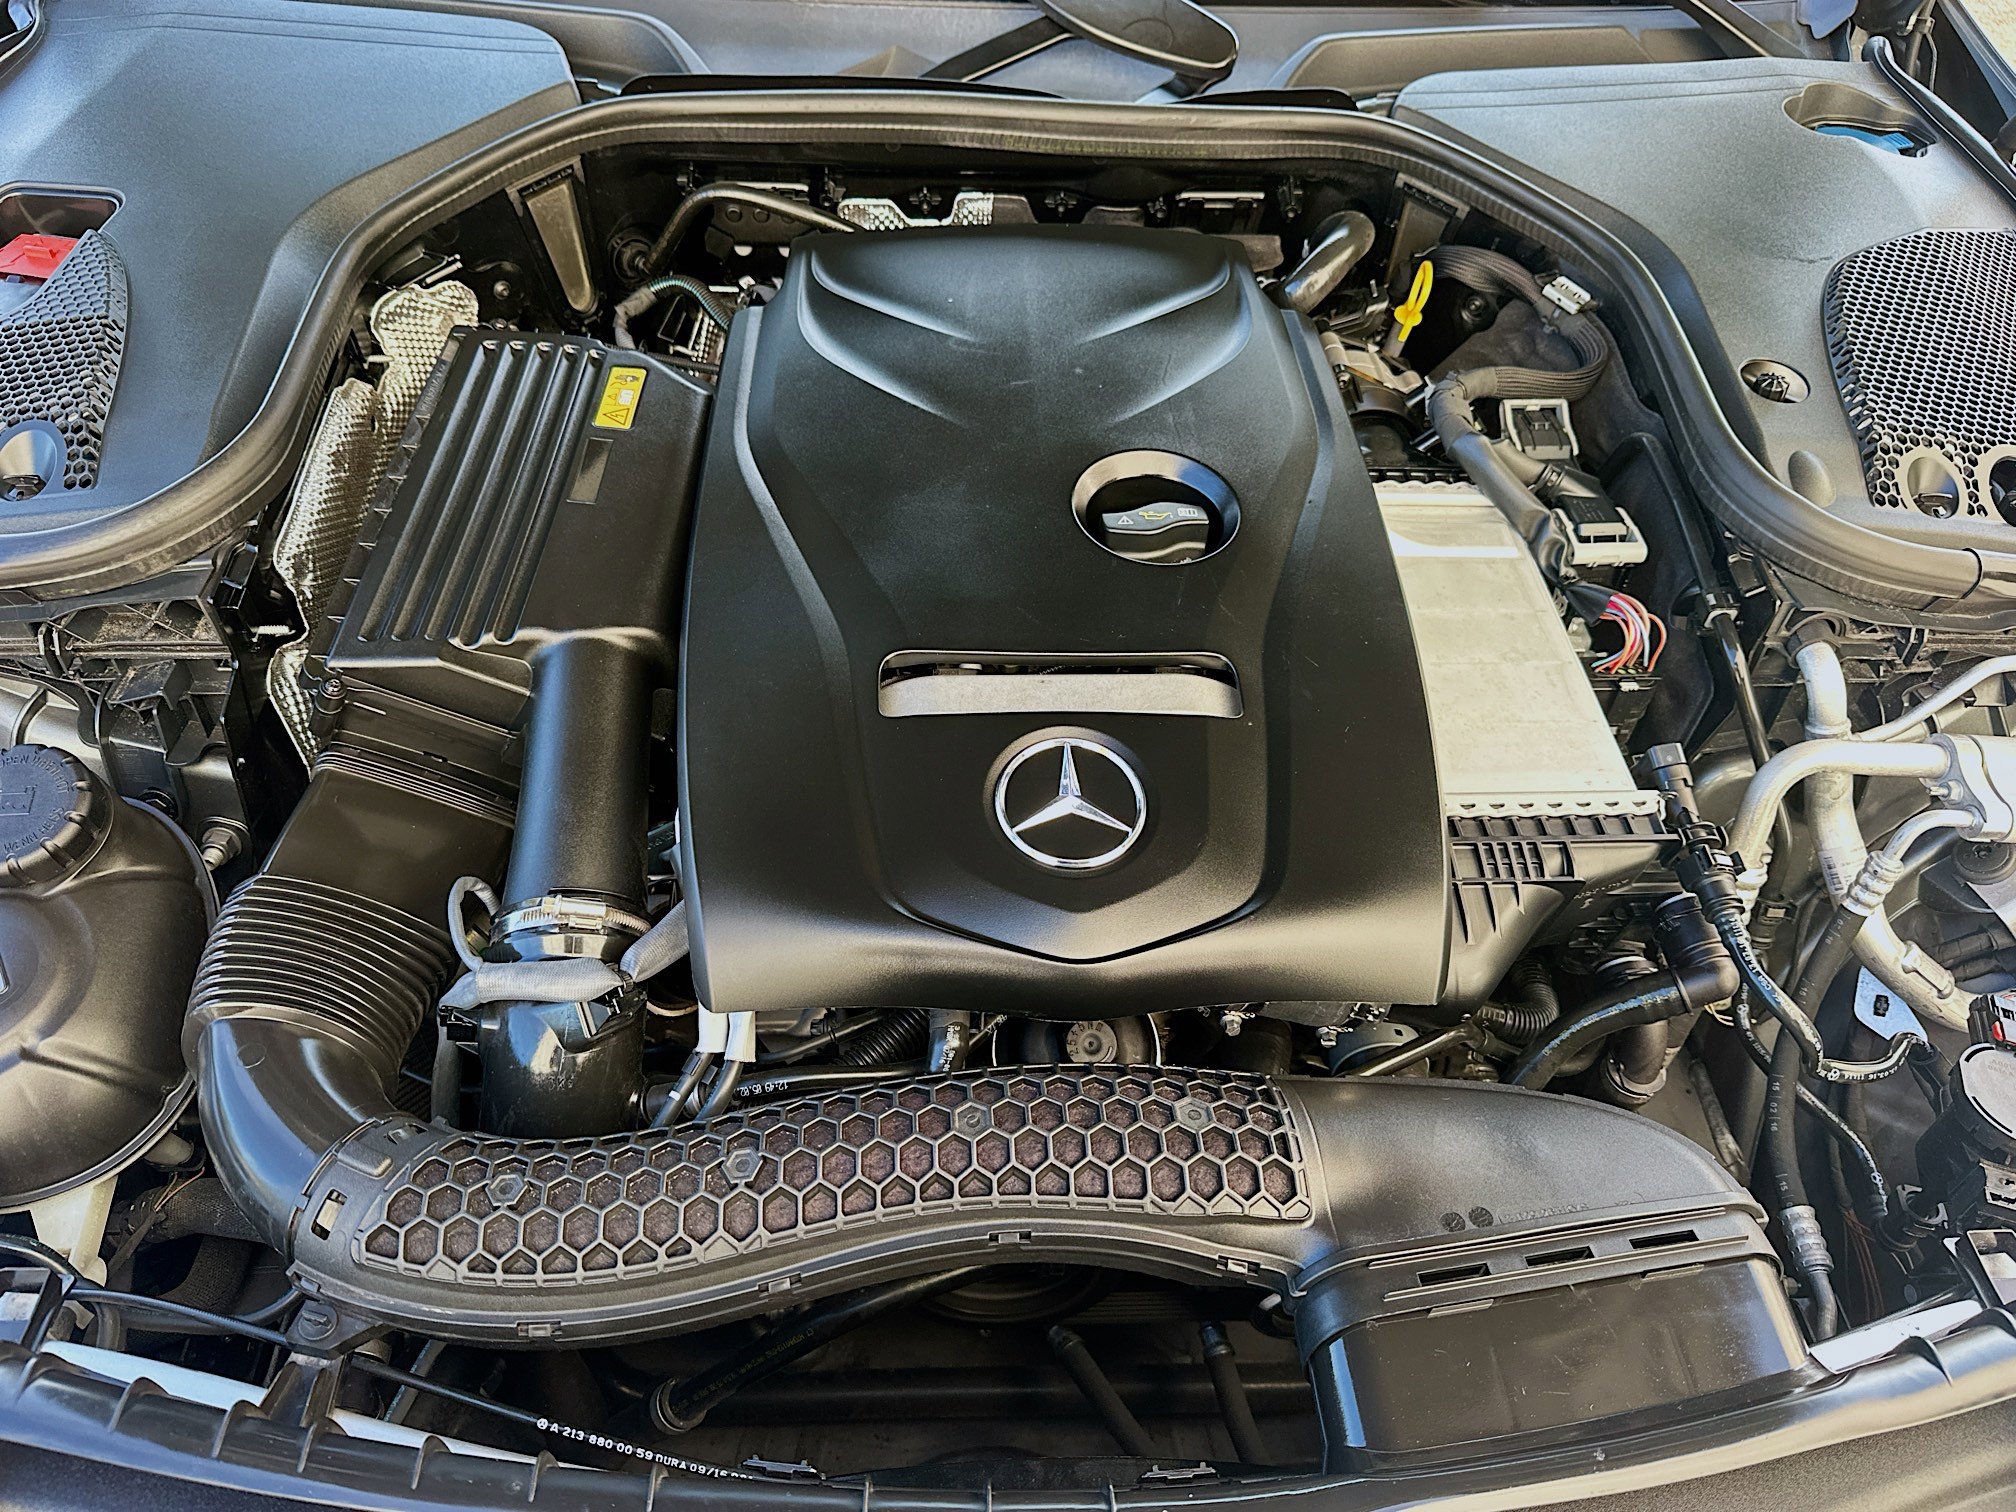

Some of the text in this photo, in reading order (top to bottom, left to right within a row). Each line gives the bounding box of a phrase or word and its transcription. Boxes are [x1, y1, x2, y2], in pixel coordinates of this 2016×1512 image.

[4, 807, 64, 854] WENN HEISS
[549, 1422, 559, 1434] A
[562, 1426, 585, 1441] 213
[588, 1434, 614, 1449] 880
[616, 1442, 633, 1455] 00
[635, 1447, 654, 1461] 59
[655, 1453, 687, 1471] DURA
